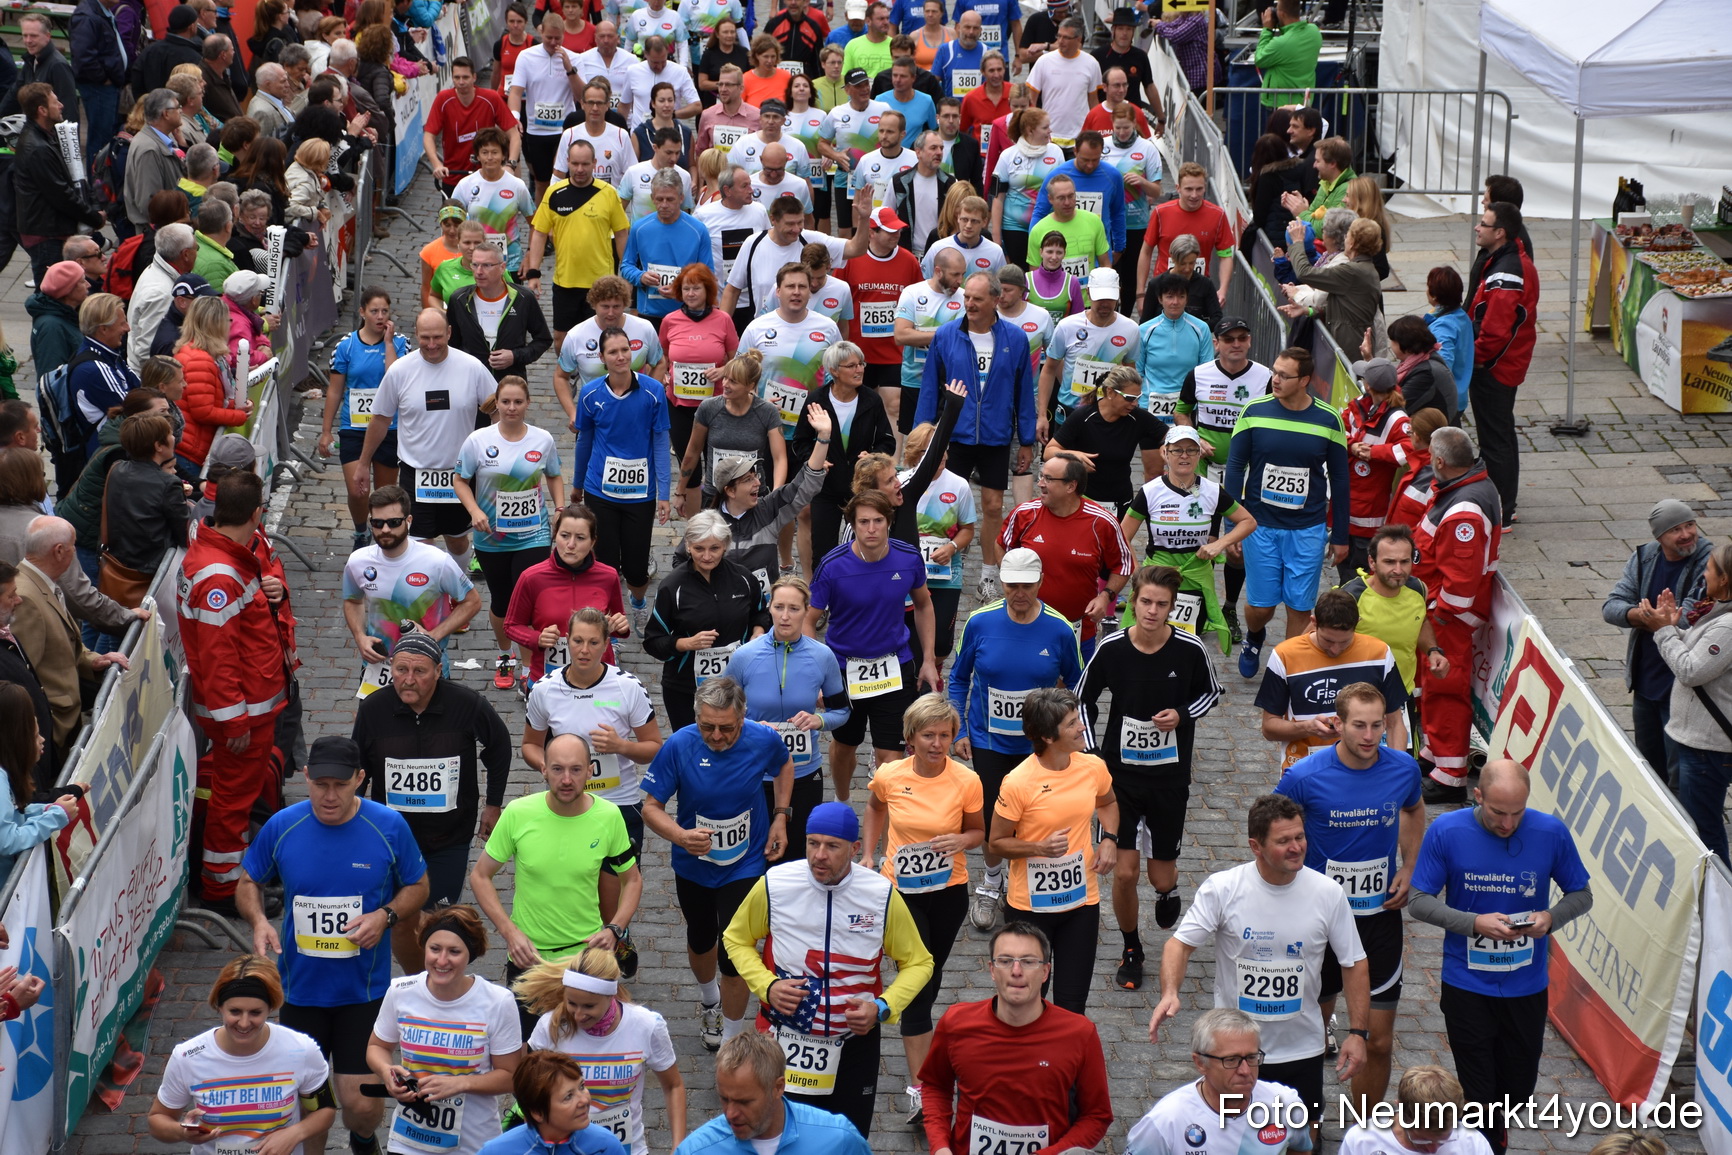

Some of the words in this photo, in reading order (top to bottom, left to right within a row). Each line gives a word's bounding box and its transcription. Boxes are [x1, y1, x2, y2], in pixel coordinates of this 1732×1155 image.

[958, 76, 977, 87] 380
[537, 109, 562, 120] 2331
[720, 133, 741, 145] 367
[270, 233, 281, 280] Laufsport
[858, 283, 898, 291] NEUMARKT
[265, 281, 276, 306] BMW
[864, 310, 894, 324] 2653
[681, 371, 707, 386] 328
[682, 387, 705, 395] Susanne
[772, 391, 797, 412] 211
[607, 468, 645, 484] 2096
[1281, 469, 1303, 477] Neumarkt
[421, 471, 455, 487] 2080
[1266, 475, 1305, 494] 2253
[425, 490, 454, 498] Wolfgang
[1273, 494, 1293, 503] Harald
[501, 499, 536, 517] 2283
[507, 519, 532, 527] Caroline
[1157, 528, 1208, 538] Laufteam
[1168, 537, 1198, 547] Fürth
[857, 661, 889, 681] 241
[859, 681, 892, 693] Christoph
[989, 691, 1006, 699] PARTL
[994, 700, 1024, 718] 302
[1123, 721, 1139, 730] PARTL
[1137, 752, 1161, 760] Martin
[386, 762, 405, 770] PARTL
[391, 771, 441, 792] 2486
[405, 796, 426, 806] Hans
[1330, 808, 1378, 818] Kirwaläufer
[697, 819, 716, 830] PARTL
[716, 820, 743, 830] Neumarkt
[1328, 818, 1379, 828] Pettenhofen
[897, 851, 949, 876] 2322
[1028, 861, 1049, 870] PARTL
[1049, 859, 1077, 869] Neumarkt
[1327, 864, 1349, 872] PARTL
[1350, 865, 1379, 873] Neumarkt
[920, 877, 932, 886] Evi
[1034, 865, 1082, 892] 2396
[1464, 872, 1515, 883] Kirwaläufer
[1464, 882, 1516, 894] Pettenhofen
[1051, 894, 1072, 904] Heidi
[294, 901, 316, 909] PARTL
[317, 902, 350, 910] Neumarkt
[307, 912, 349, 935] 158
[315, 940, 340, 950] Franz
[1489, 955, 1515, 963] Benni
[1238, 963, 1260, 972] PARTL
[1244, 973, 1299, 998] 2298
[1255, 1002, 1286, 1013] Hubert
[402, 1026, 432, 1045] LÄUFT
[432, 1031, 452, 1048] BEI
[452, 1033, 474, 1050] MIR
[776, 1030, 798, 1041] PARTL
[799, 1035, 833, 1046] Neumarkt
[786, 1043, 829, 1072] 253
[593, 1065, 610, 1079] BEI
[613, 1064, 633, 1079] MIR
[787, 1073, 819, 1087] Jürgen
[202, 1089, 237, 1106] LÄUFT
[240, 1088, 260, 1104] BEI
[261, 1086, 283, 1102] MIR
[405, 1125, 442, 1144] Ramona
[973, 1123, 997, 1135] PARTL
[998, 1129, 1035, 1140] Neumarkt
